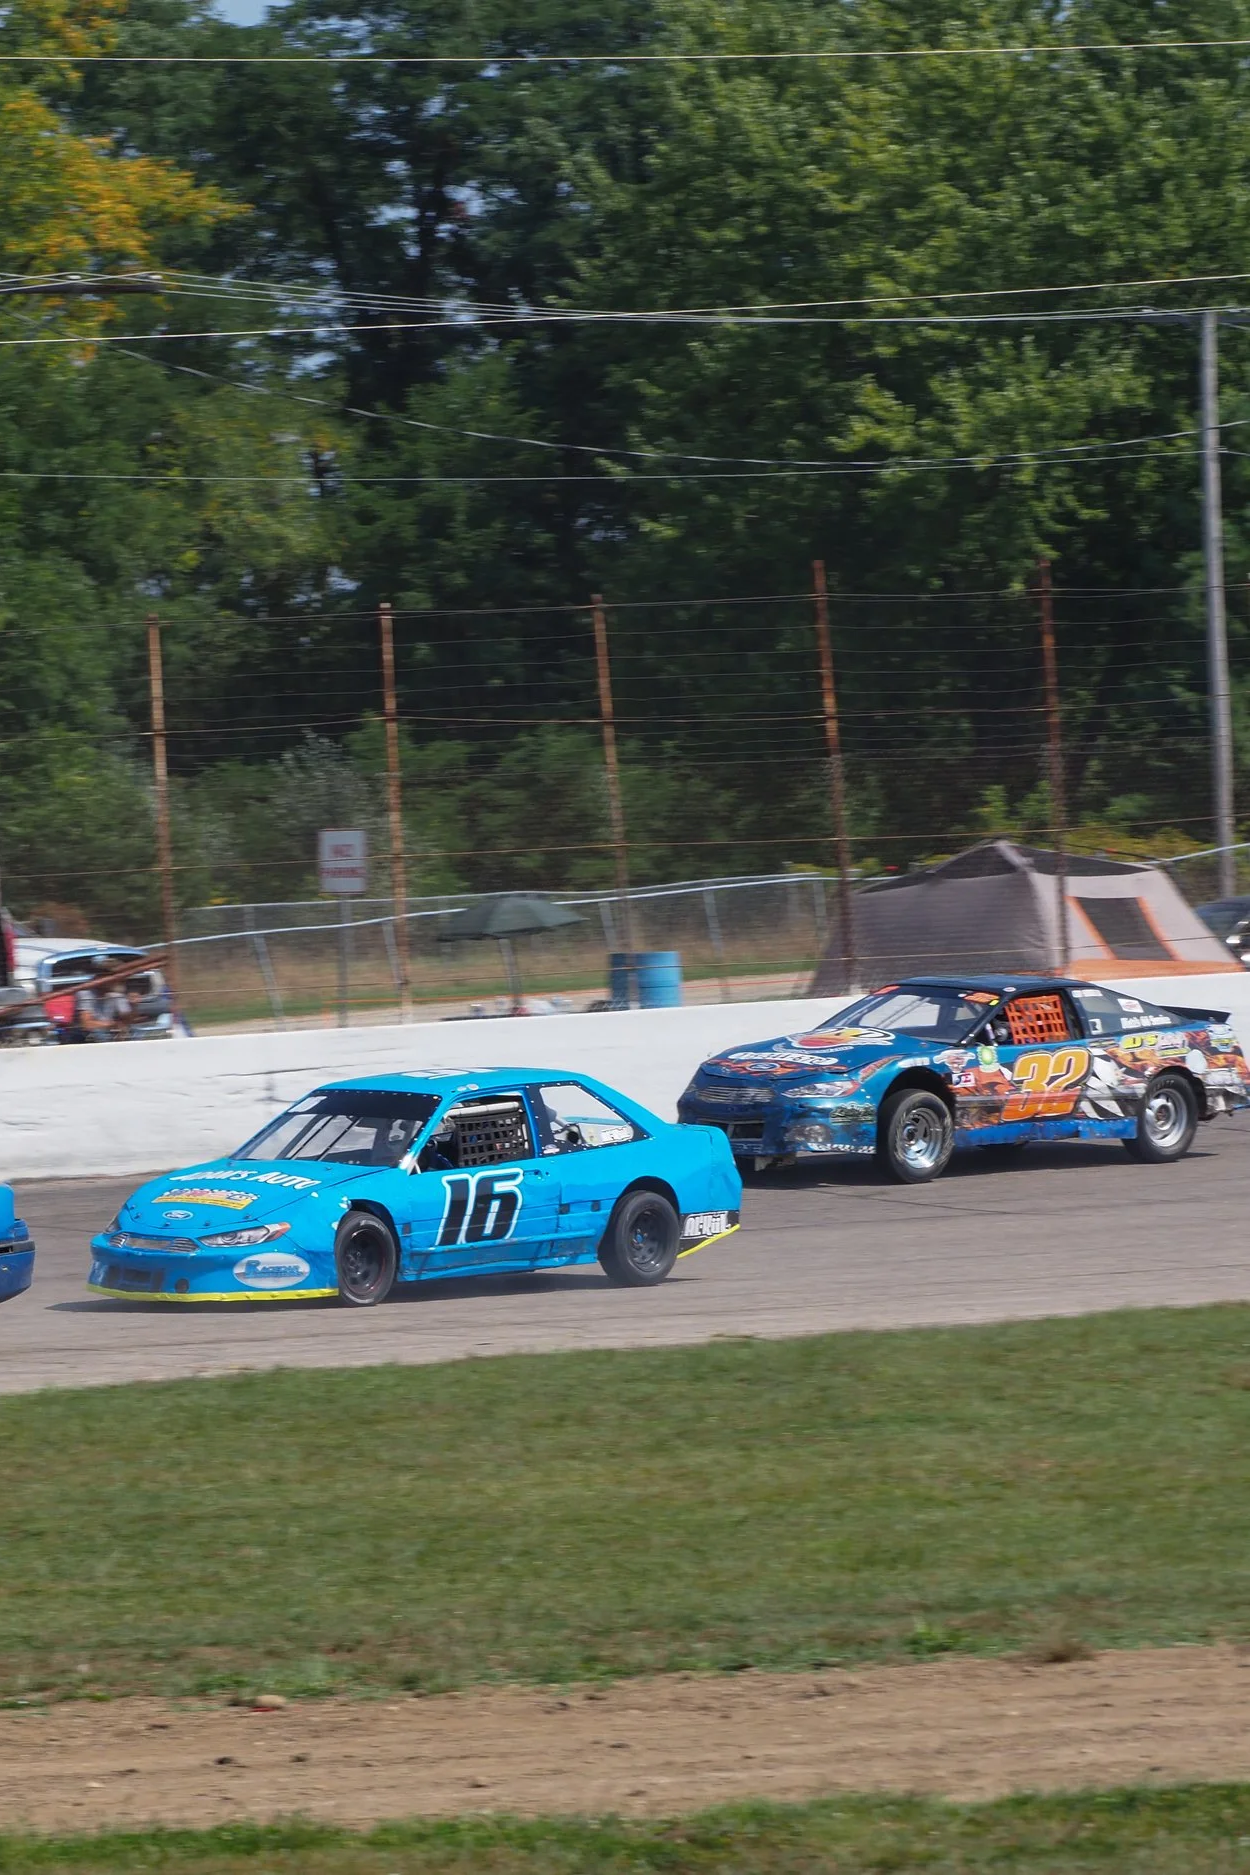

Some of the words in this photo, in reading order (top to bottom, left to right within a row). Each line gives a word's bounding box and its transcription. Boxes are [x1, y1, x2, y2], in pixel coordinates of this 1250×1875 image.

[1001, 1048, 1091, 1121] 32
[246, 1171, 322, 1190] AUTO
[435, 1167, 524, 1246] 16
